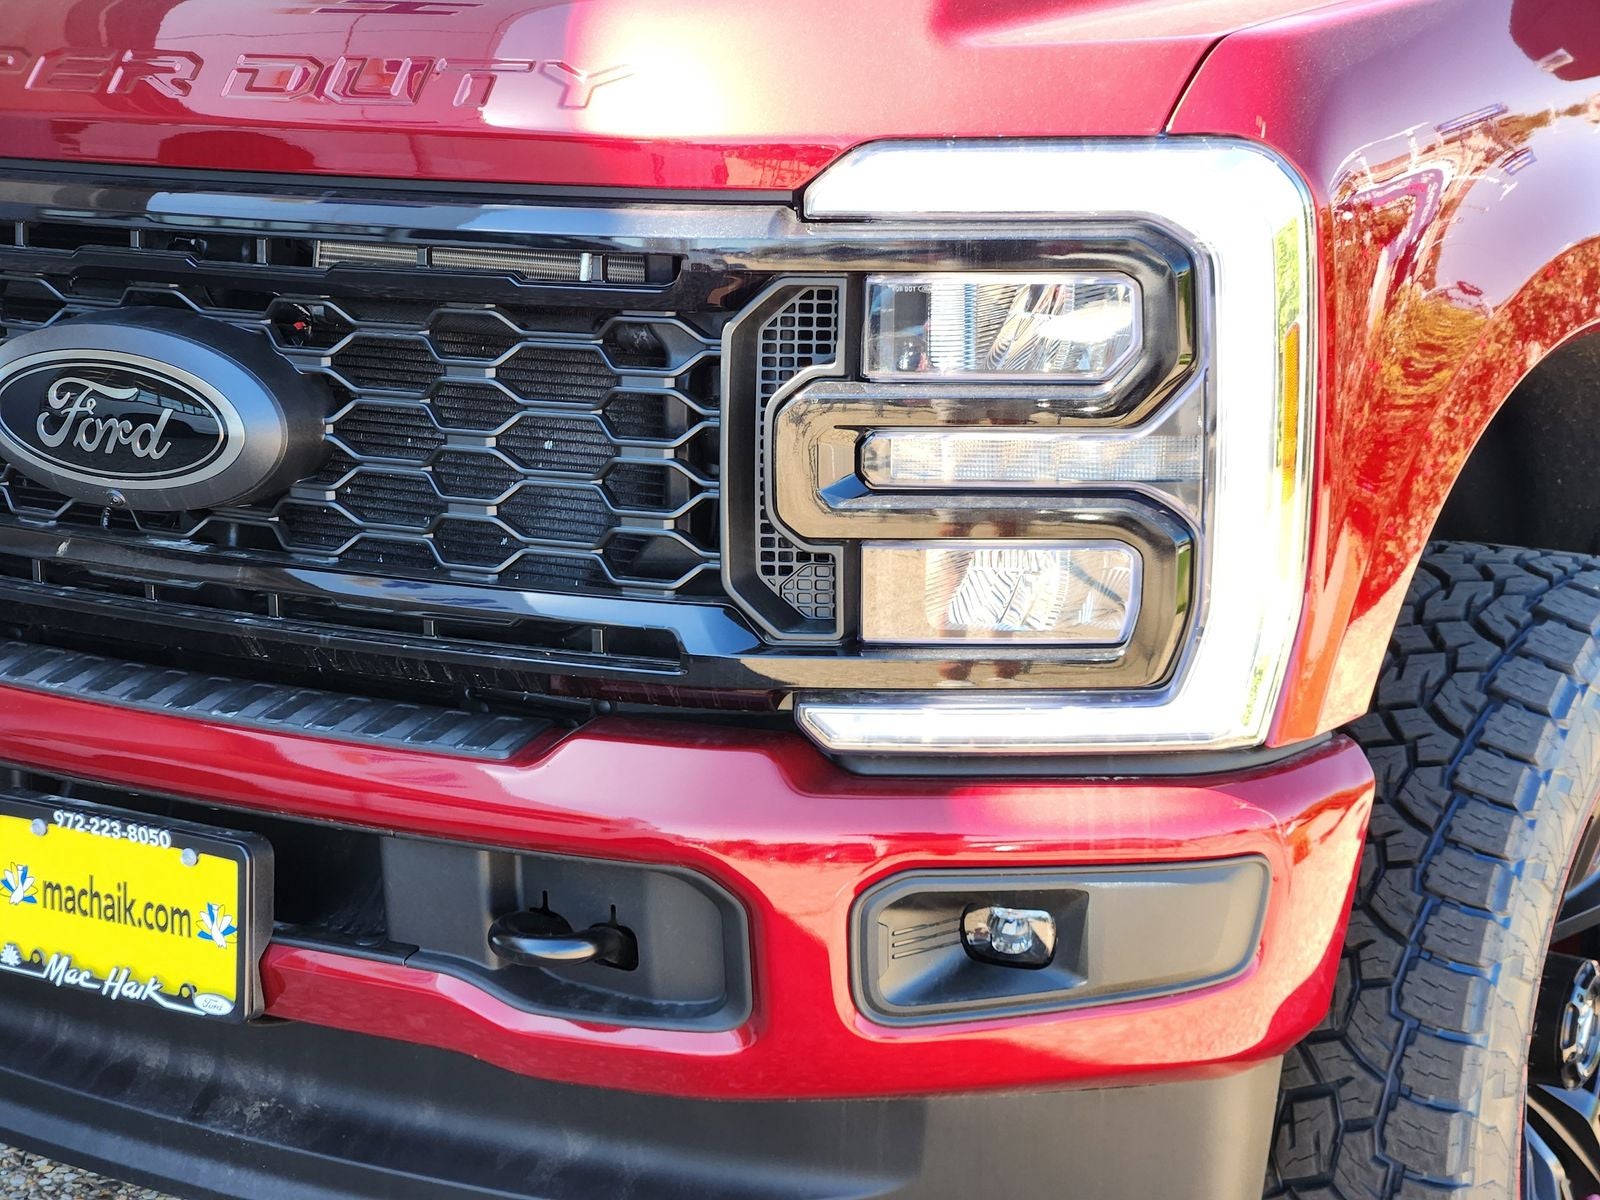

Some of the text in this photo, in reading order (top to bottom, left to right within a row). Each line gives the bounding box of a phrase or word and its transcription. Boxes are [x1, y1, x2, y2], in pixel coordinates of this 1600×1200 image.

[220, 54, 634, 108] DUTY
[36, 377, 174, 460] Ford
[53, 810, 171, 849] 972-223-8050
[42, 875, 192, 938] machaik.com
[43, 953, 163, 1001] Mac Haik
[202, 998, 223, 1011] Ford
